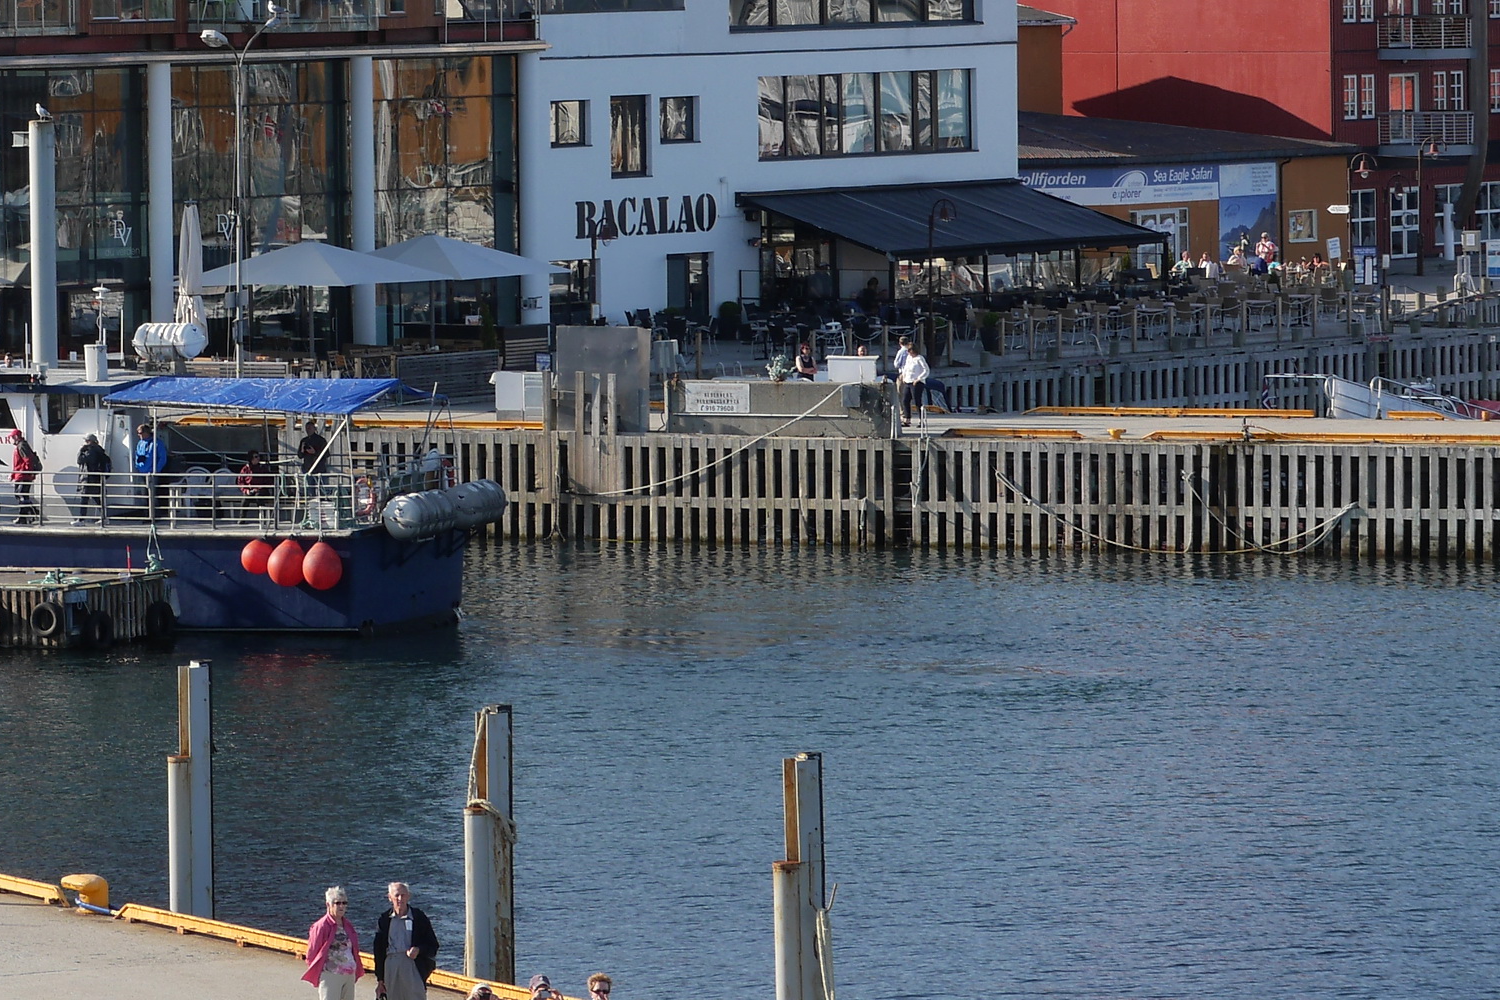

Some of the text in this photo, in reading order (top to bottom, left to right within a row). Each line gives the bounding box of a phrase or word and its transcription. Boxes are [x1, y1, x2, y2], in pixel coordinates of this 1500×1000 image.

[1153, 166, 1214, 184] Sea Eagle Safari
[575, 193, 717, 239] BACALAO
